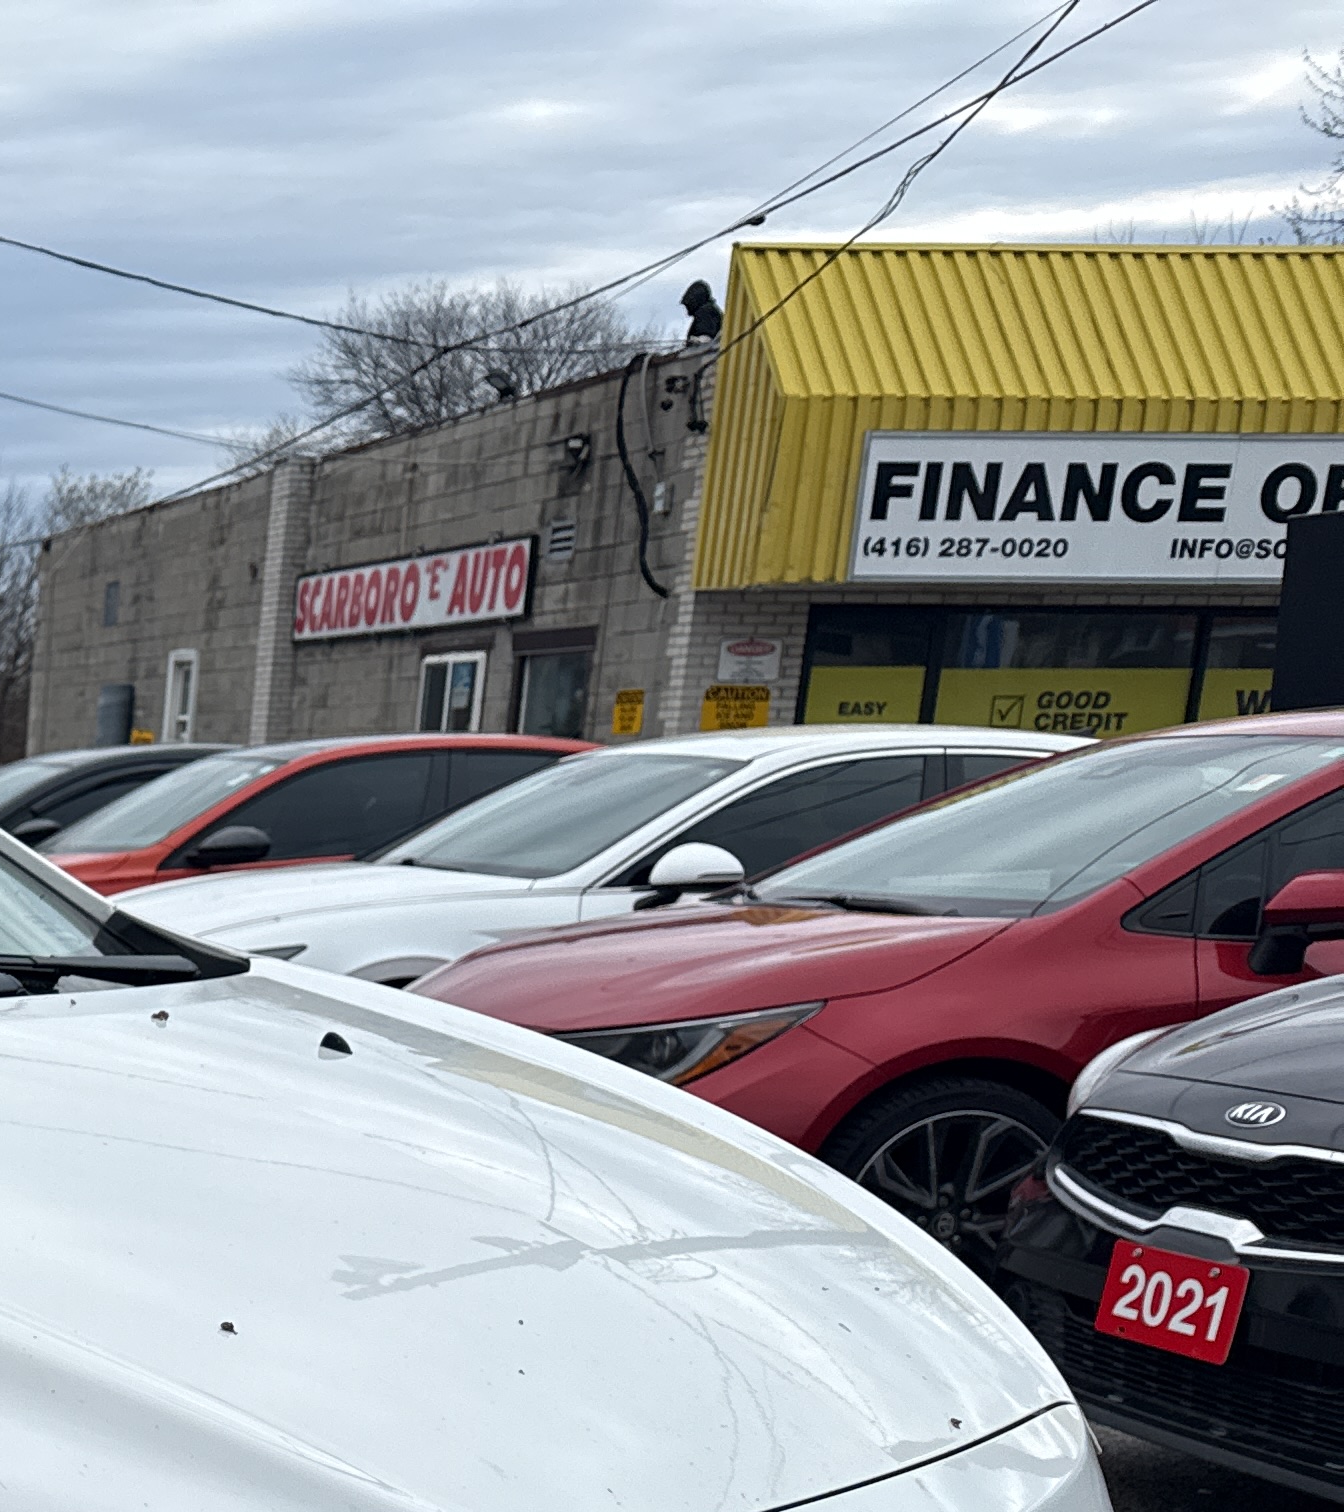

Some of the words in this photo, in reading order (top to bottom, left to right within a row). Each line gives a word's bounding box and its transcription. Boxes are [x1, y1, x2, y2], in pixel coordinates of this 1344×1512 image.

[870, 461, 1233, 522] FINANCE
[863, 537, 930, 558] (416)
[938, 537, 1069, 559] 287-0020
[295, 562, 420, 634] SCARBORO
[447, 543, 526, 616] AUTO
[708, 688, 768, 699] CAUTION
[1037, 690, 1111, 710] GOOD
[838, 702, 887, 716] EASY
[1034, 712, 1129, 732] CREDIT
[1228, 1102, 1277, 1123] KIA
[1112, 1264, 1230, 1342] 2021
